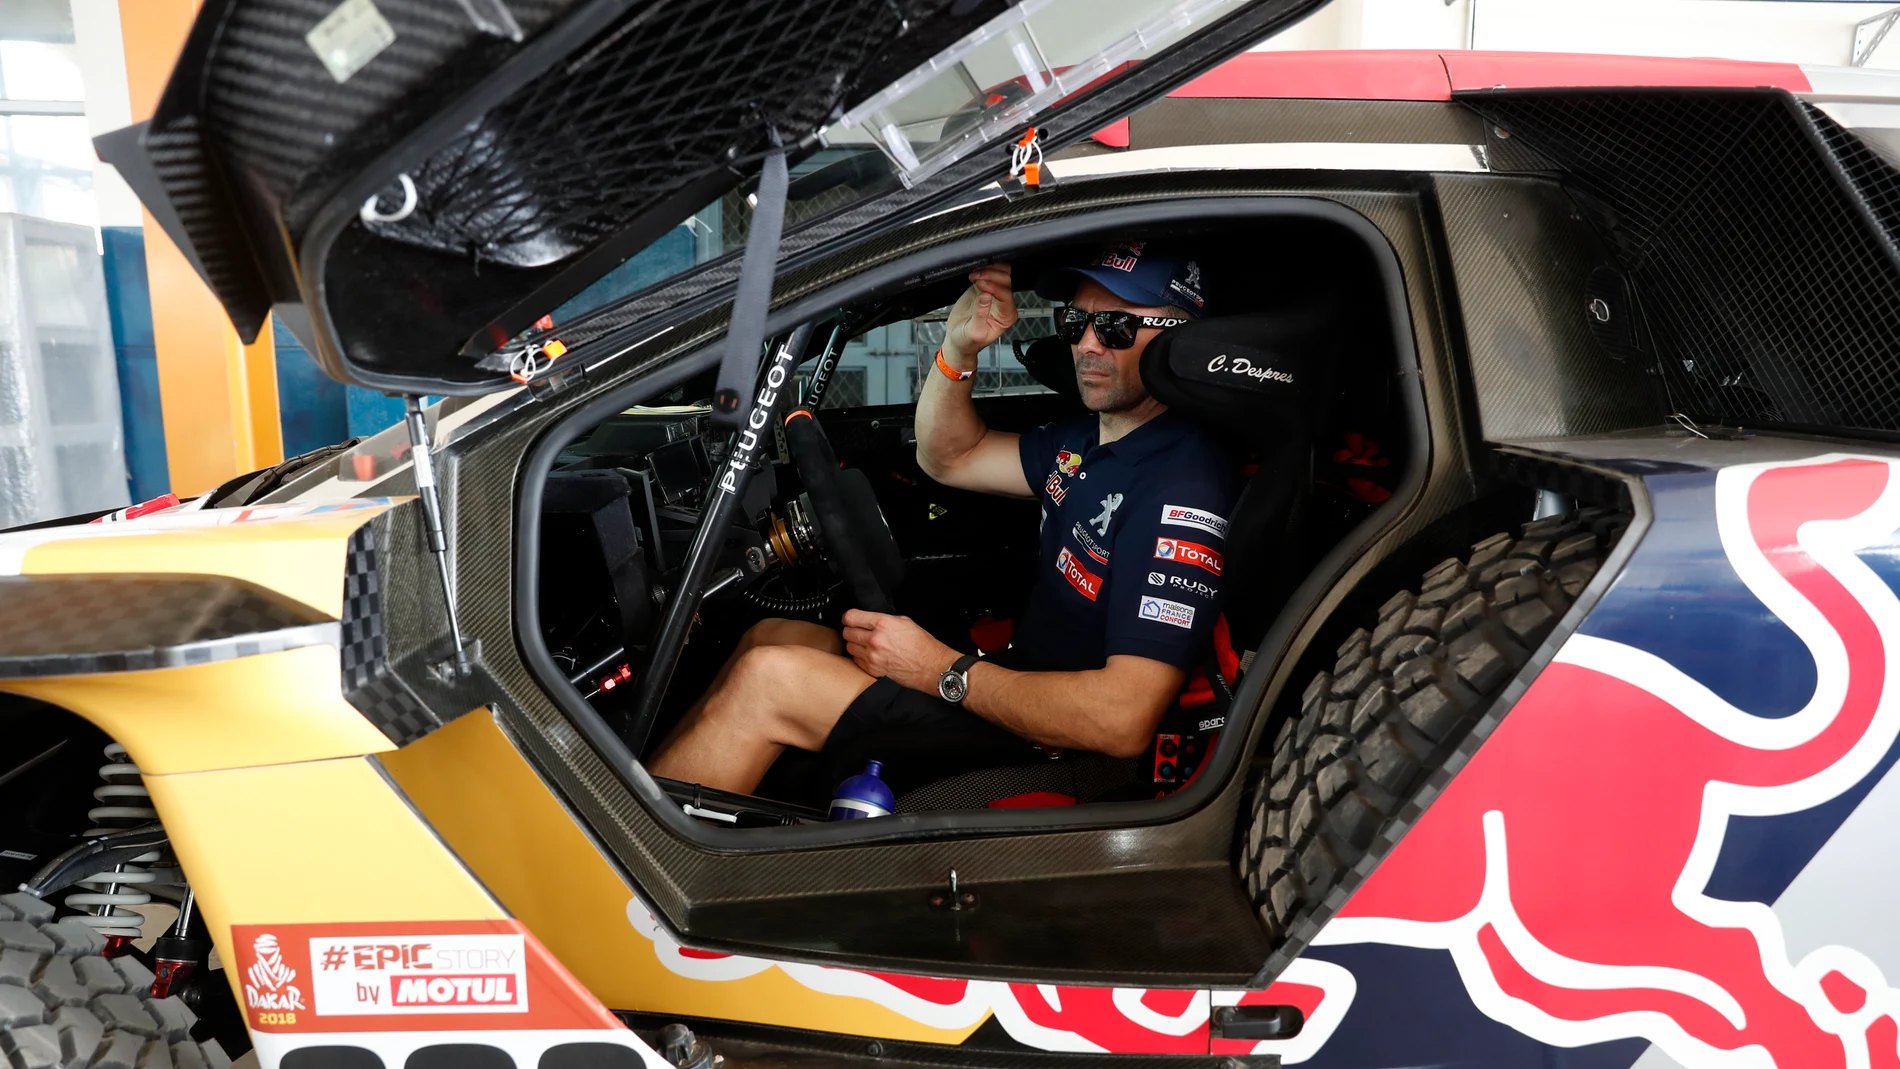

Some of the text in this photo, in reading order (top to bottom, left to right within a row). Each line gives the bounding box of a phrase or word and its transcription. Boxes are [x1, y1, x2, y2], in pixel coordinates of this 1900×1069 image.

[1102, 252, 1138, 273] Bull
[807, 347, 838, 411] UGEOT
[721, 344, 793, 493] PEUGEOT
[1169, 509, 1226, 532] BFGoodrich
[1177, 545, 1221, 570] TOTAL
[1067, 560, 1096, 595] TOTAL
[1169, 575, 1218, 597] RUDY
[1161, 609, 1192, 620] FRANCE
[1163, 602, 1193, 615] maisons
[1160, 614, 1190, 626] CONFORT
[1198, 716, 1225, 730] sparc
[245, 984, 306, 1011] DAKAR
[356, 977, 513, 1005] by MOTUL
[258, 1012, 297, 1025] 2018
